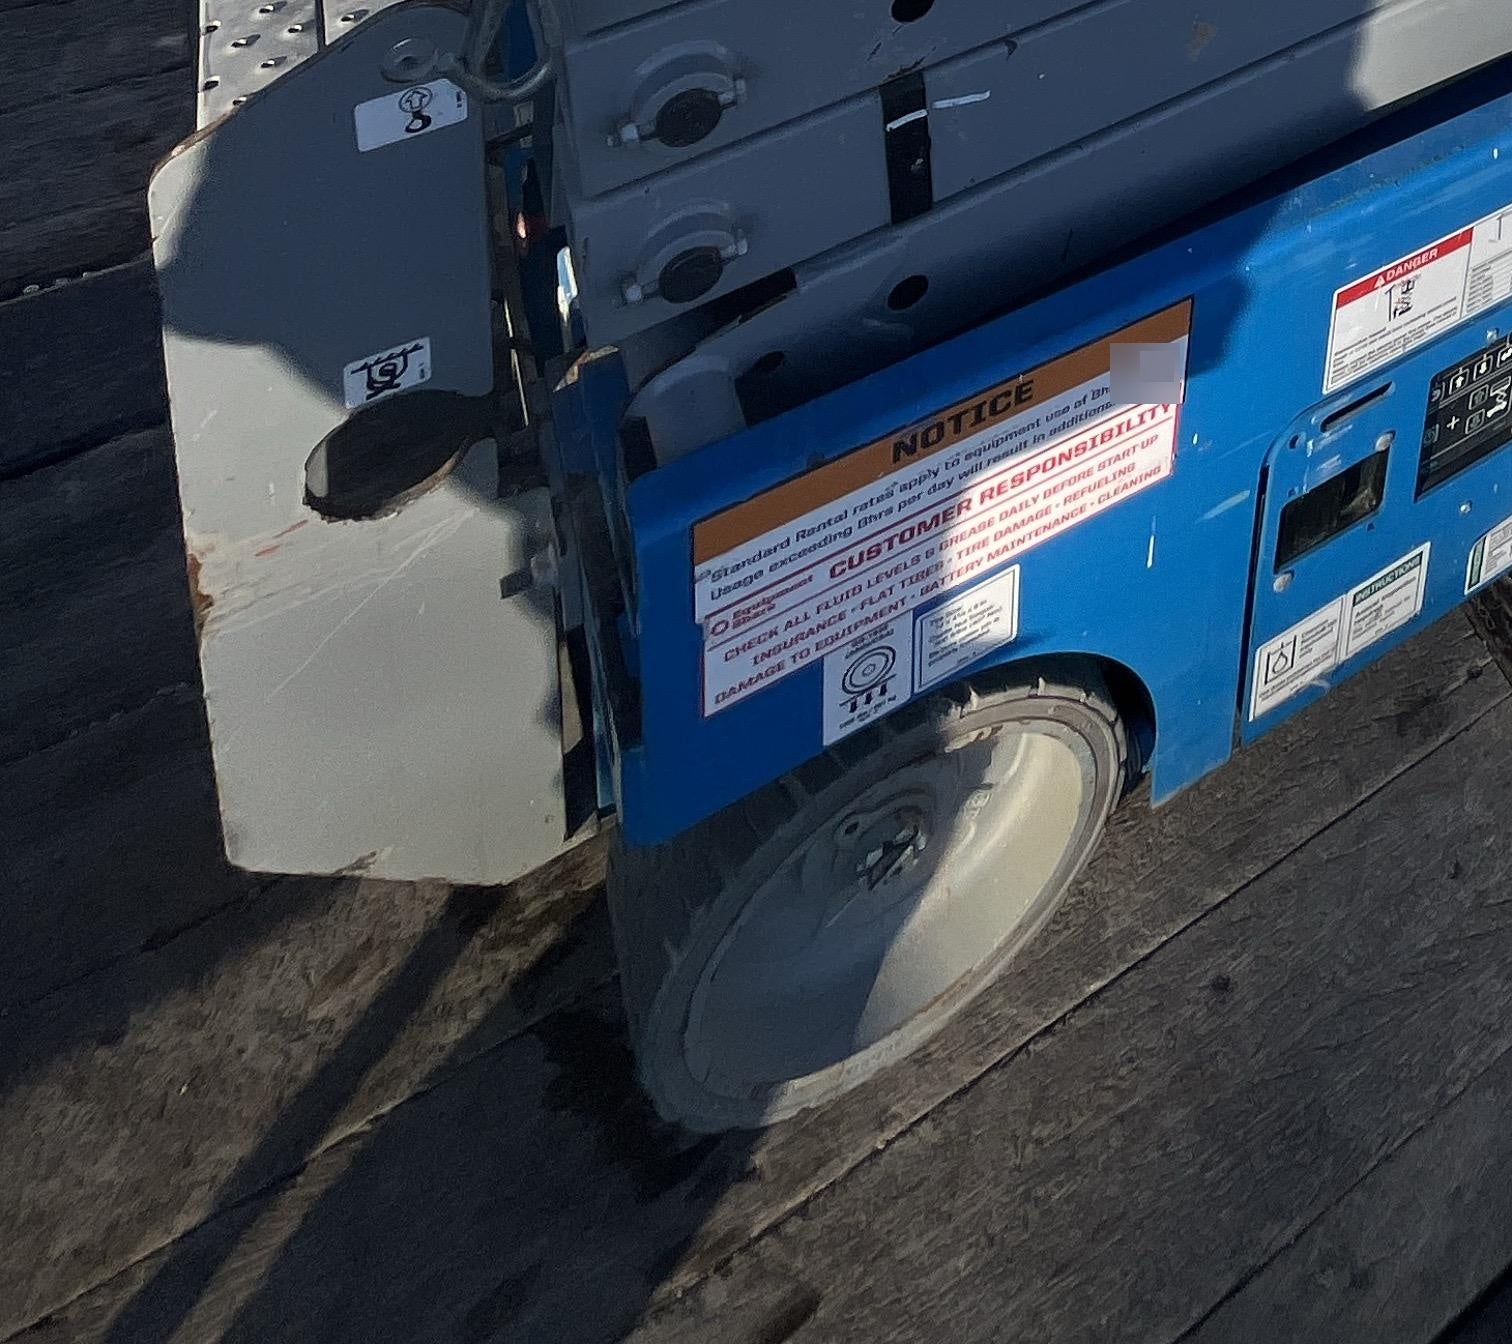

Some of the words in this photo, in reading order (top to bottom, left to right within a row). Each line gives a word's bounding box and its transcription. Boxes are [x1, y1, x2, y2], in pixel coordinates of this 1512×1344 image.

[1386, 247, 1439, 280] DANGER
[711, 537, 790, 583] Standard
[795, 509, 848, 543] Rental
[852, 489, 894, 516] rates
[900, 467, 940, 494] apply
[945, 455, 960, 471] to
[964, 418, 1040, 460] equipment
[1045, 406, 1070, 423] use
[1074, 393, 1088, 411] of
[829, 497, 972, 579] CUSTOMER
[979, 403, 1172, 505] RESPONSIBILITY
[892, 378, 1034, 463] NOTICE
[710, 570, 764, 601] Usage
[769, 526, 853, 573] exceeding
[897, 490, 923, 513] per
[927, 472, 954, 496] day
[958, 456, 984, 480] will
[987, 439, 1028, 468] result
[1033, 431, 1046, 445] in
[714, 660, 786, 705] DAMAGE
[791, 647, 812, 664] TO
[814, 598, 907, 653] EQUIPMENT
[919, 557, 985, 595] BATTERY
[987, 501, 1088, 560] MAINTENANCE
[1097, 465, 1162, 504] CLEANING
[724, 625, 779, 662] CHECK
[783, 612, 811, 633] ALL
[815, 584, 863, 615] FLUID
[867, 554, 921, 589] LEVELS
[939, 516, 996, 552] GREASE
[999, 494, 1040, 522] DAILY
[1043, 467, 1095, 499] BEFORE
[752, 611, 848, 666] INSURANCE
[860, 586, 896, 611] FLAT
[900, 560, 945, 589] TIRES
[956, 536, 990, 562] TIRE
[993, 505, 1053, 541] DAMAGE
[1063, 462, 1136, 506] REFUELING
